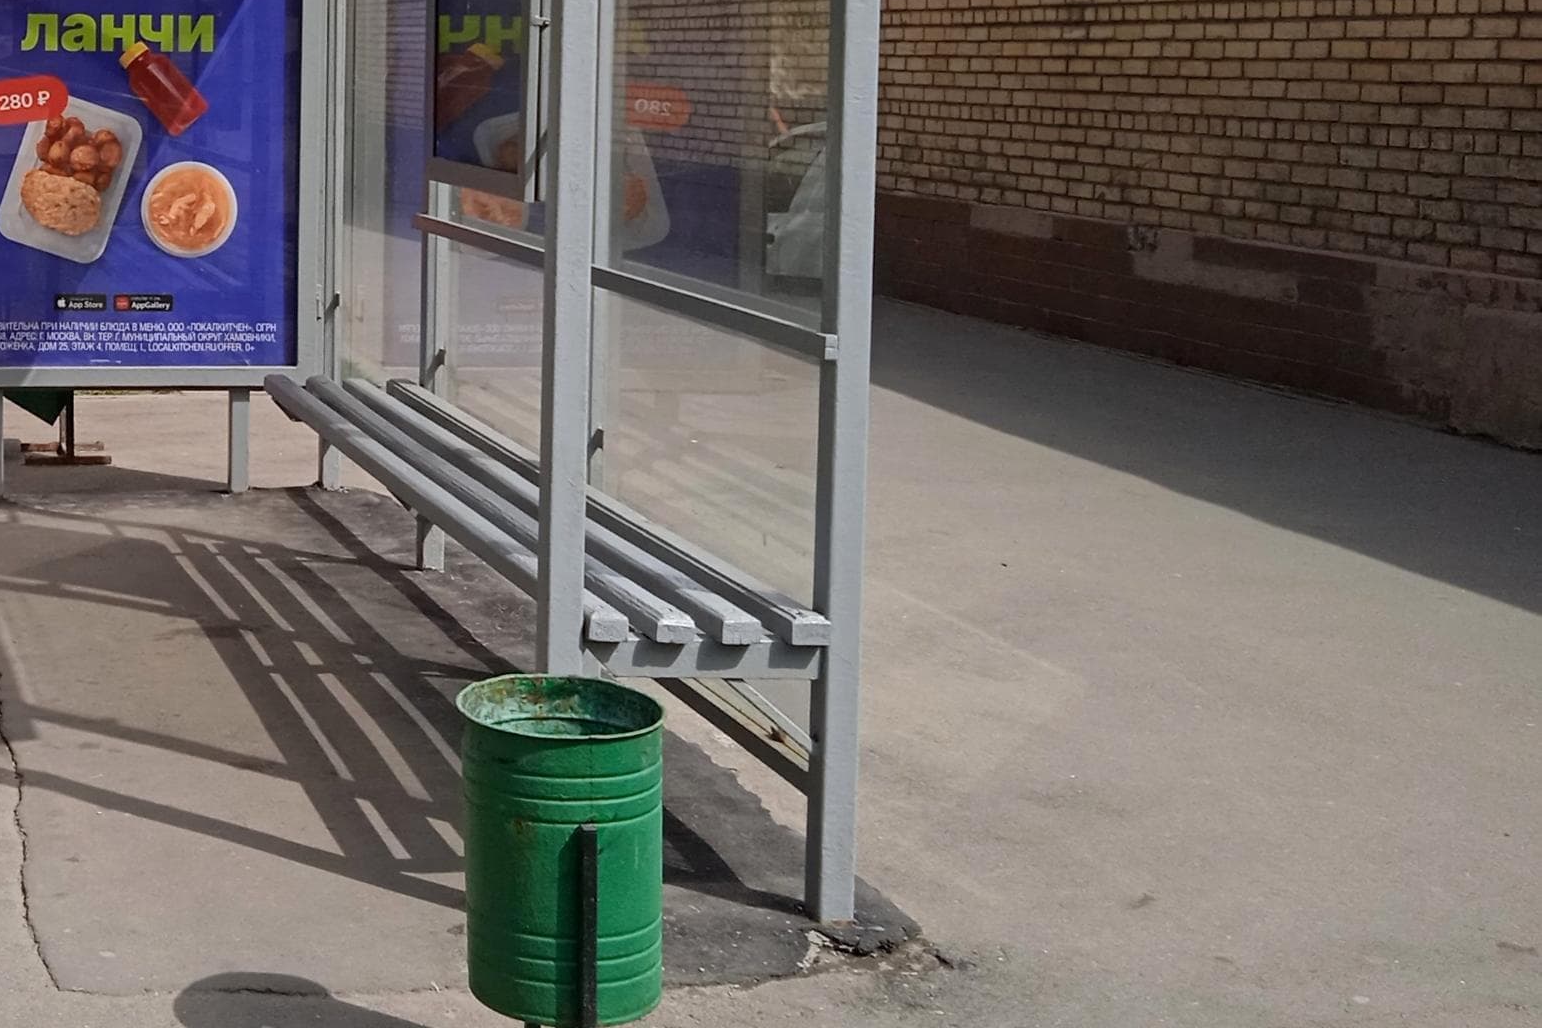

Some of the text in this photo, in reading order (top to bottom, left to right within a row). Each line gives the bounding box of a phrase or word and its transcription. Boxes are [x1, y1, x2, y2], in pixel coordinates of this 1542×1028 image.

[21, 12, 215, 53] ланчи
[68, 300, 103, 310] App Store
[131, 301, 171, 310] AppGallery
[41, 322, 58, 331] ПРИ
[59, 322, 98, 331] НАЛИЧИИ
[100, 322, 130, 332] БЛЮДА
[131, 322, 138, 331] В
[167, 322, 185, 331] ООО
[255, 322, 276, 332] ОГРН
[121, 332, 196, 342] МУНИЦИПАЛЬНЫЙ
[197, 332, 223, 342] ОКРУГ
[38, 342, 57, 352] ДОМ
[71, 342, 95, 351] ЭТАЖ
